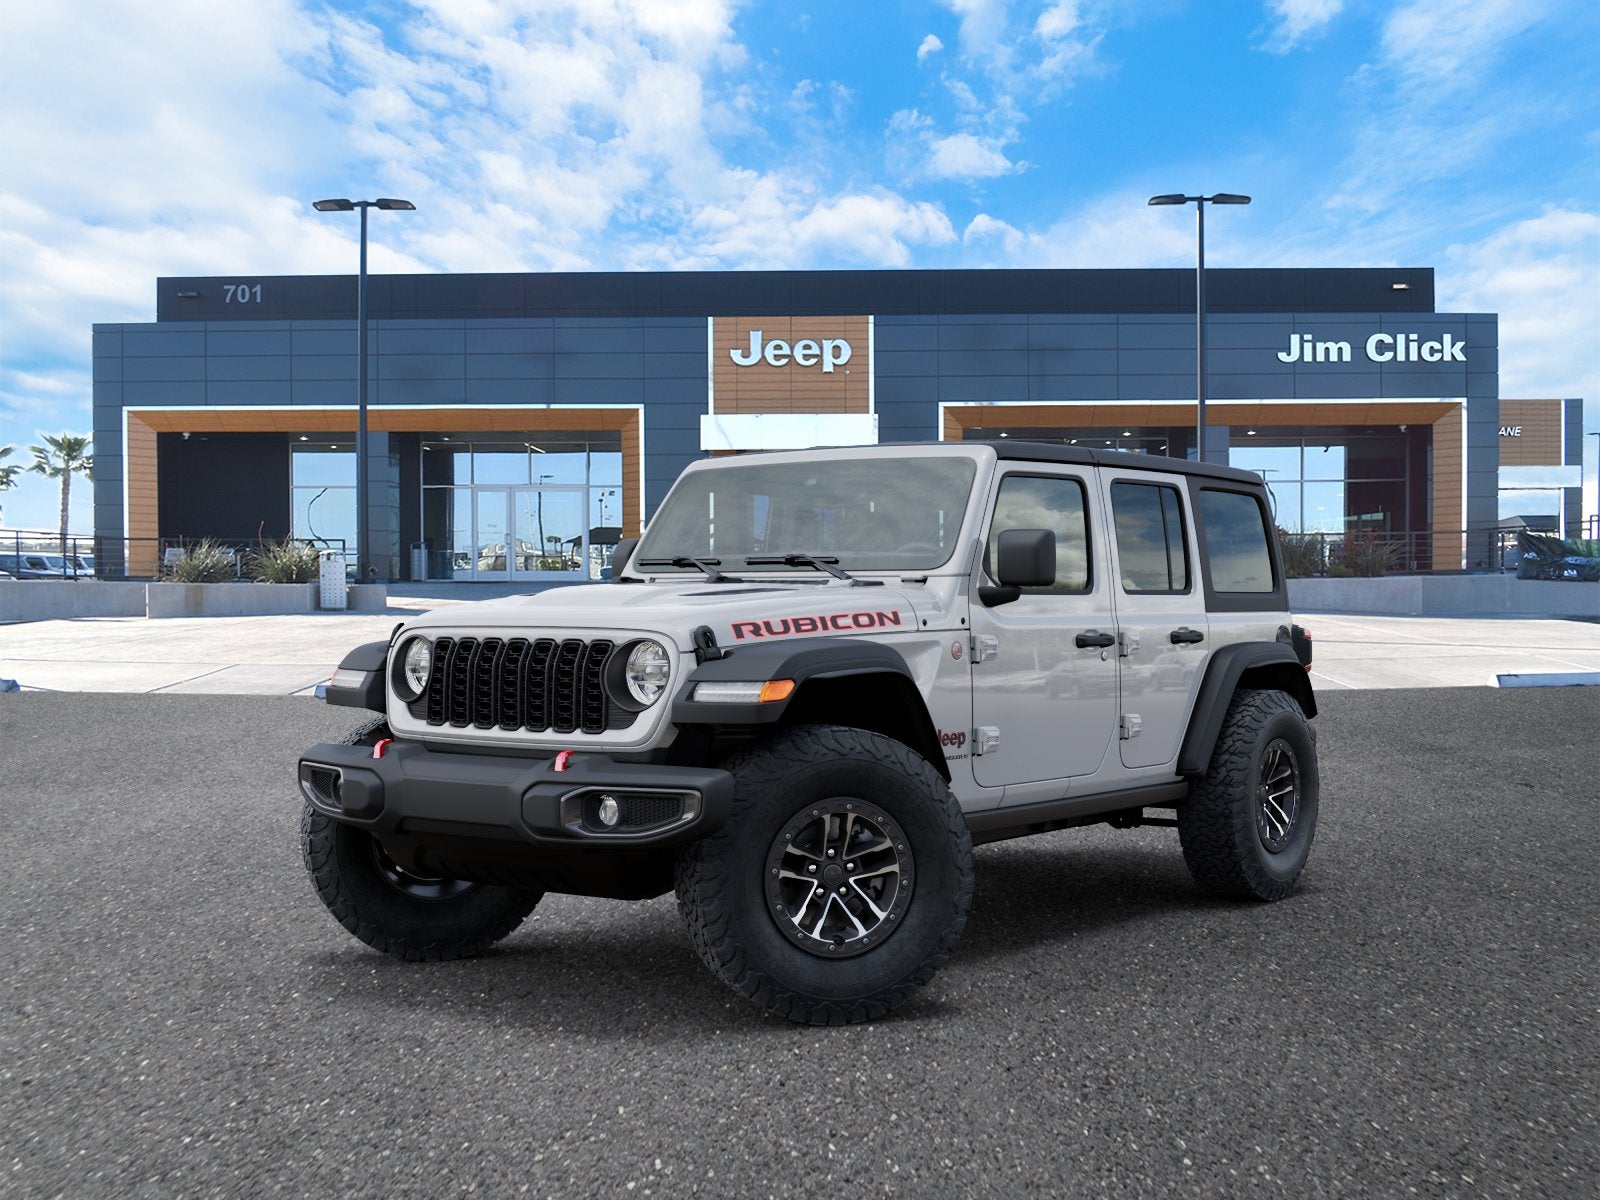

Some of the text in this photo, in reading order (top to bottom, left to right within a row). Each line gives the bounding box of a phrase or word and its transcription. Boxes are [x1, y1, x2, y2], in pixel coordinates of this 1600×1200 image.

[223, 284, 262, 304] 701
[730, 330, 852, 373] Jeep
[1277, 333, 1467, 363] Jim Click
[730, 609, 902, 641] RUBICON
